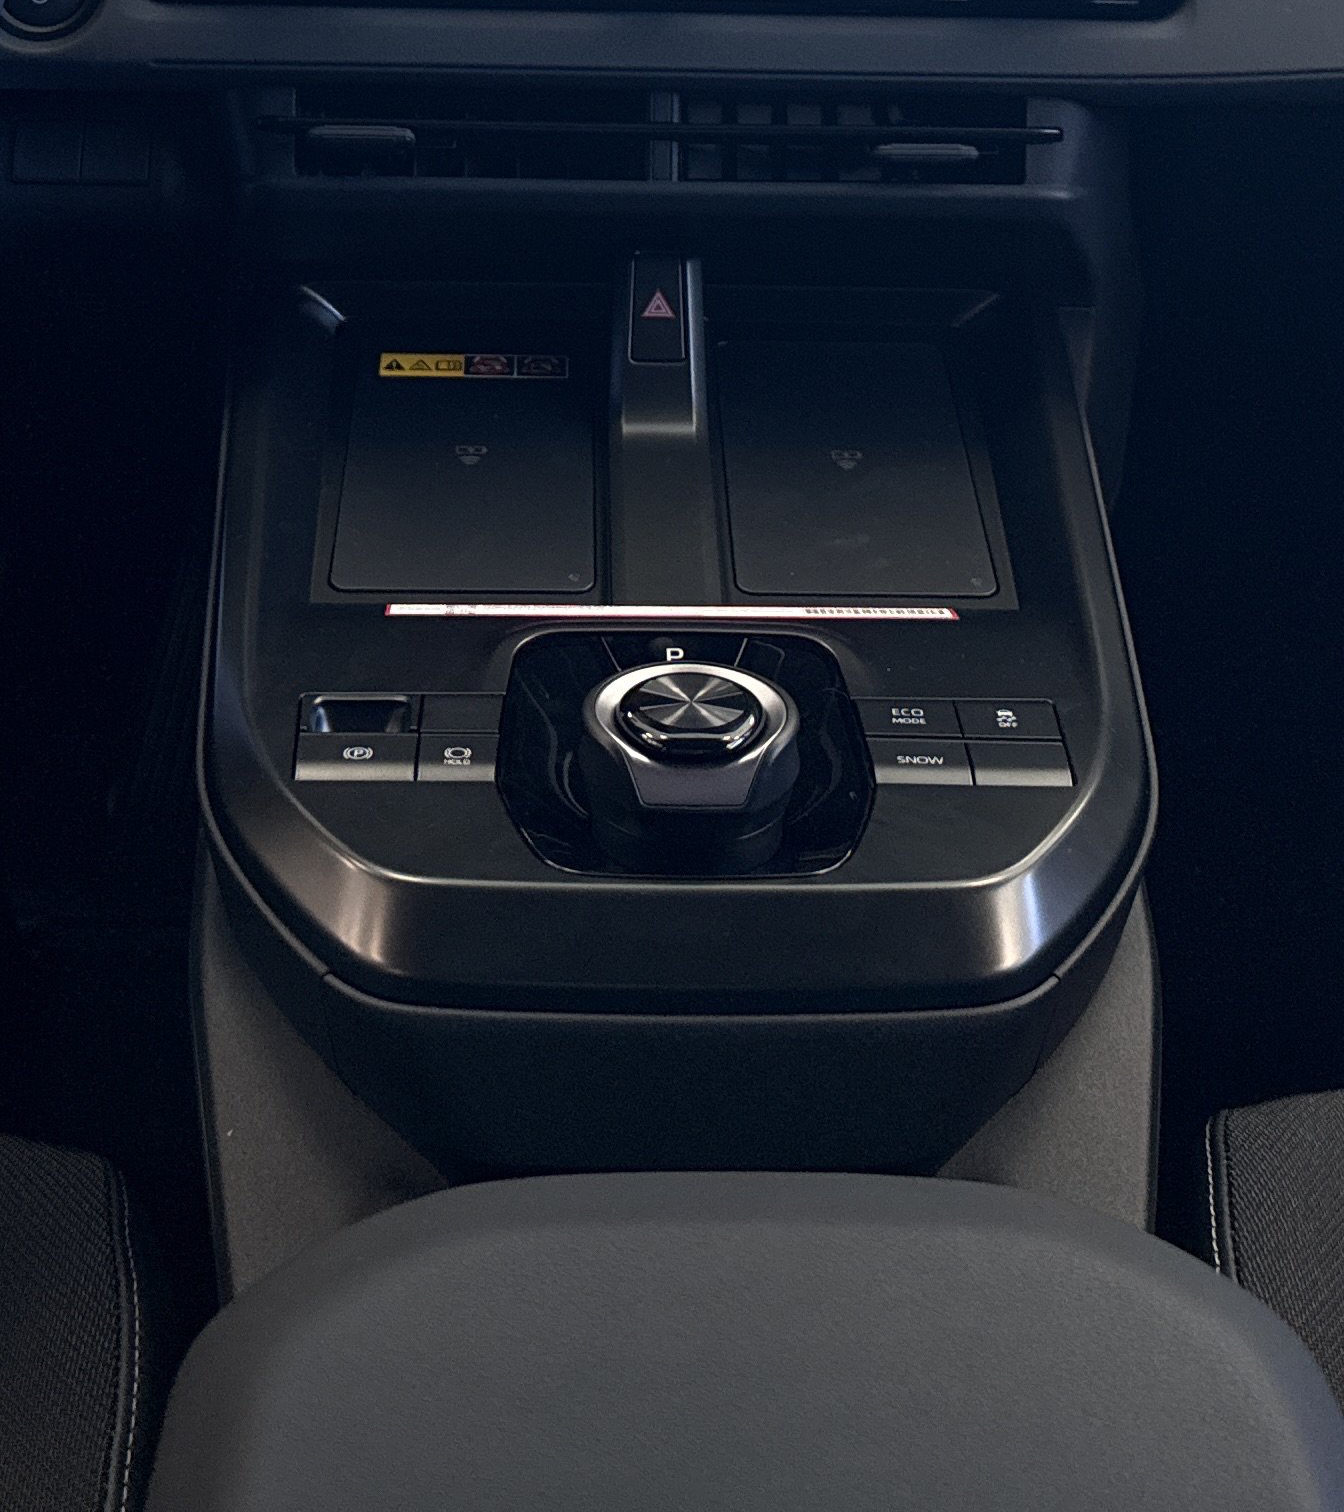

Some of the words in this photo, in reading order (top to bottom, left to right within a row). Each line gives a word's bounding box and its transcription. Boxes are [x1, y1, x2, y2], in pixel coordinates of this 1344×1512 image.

[666, 648, 684, 661] P
[892, 708, 924, 717] ECO
[896, 756, 944, 765] SNOW
